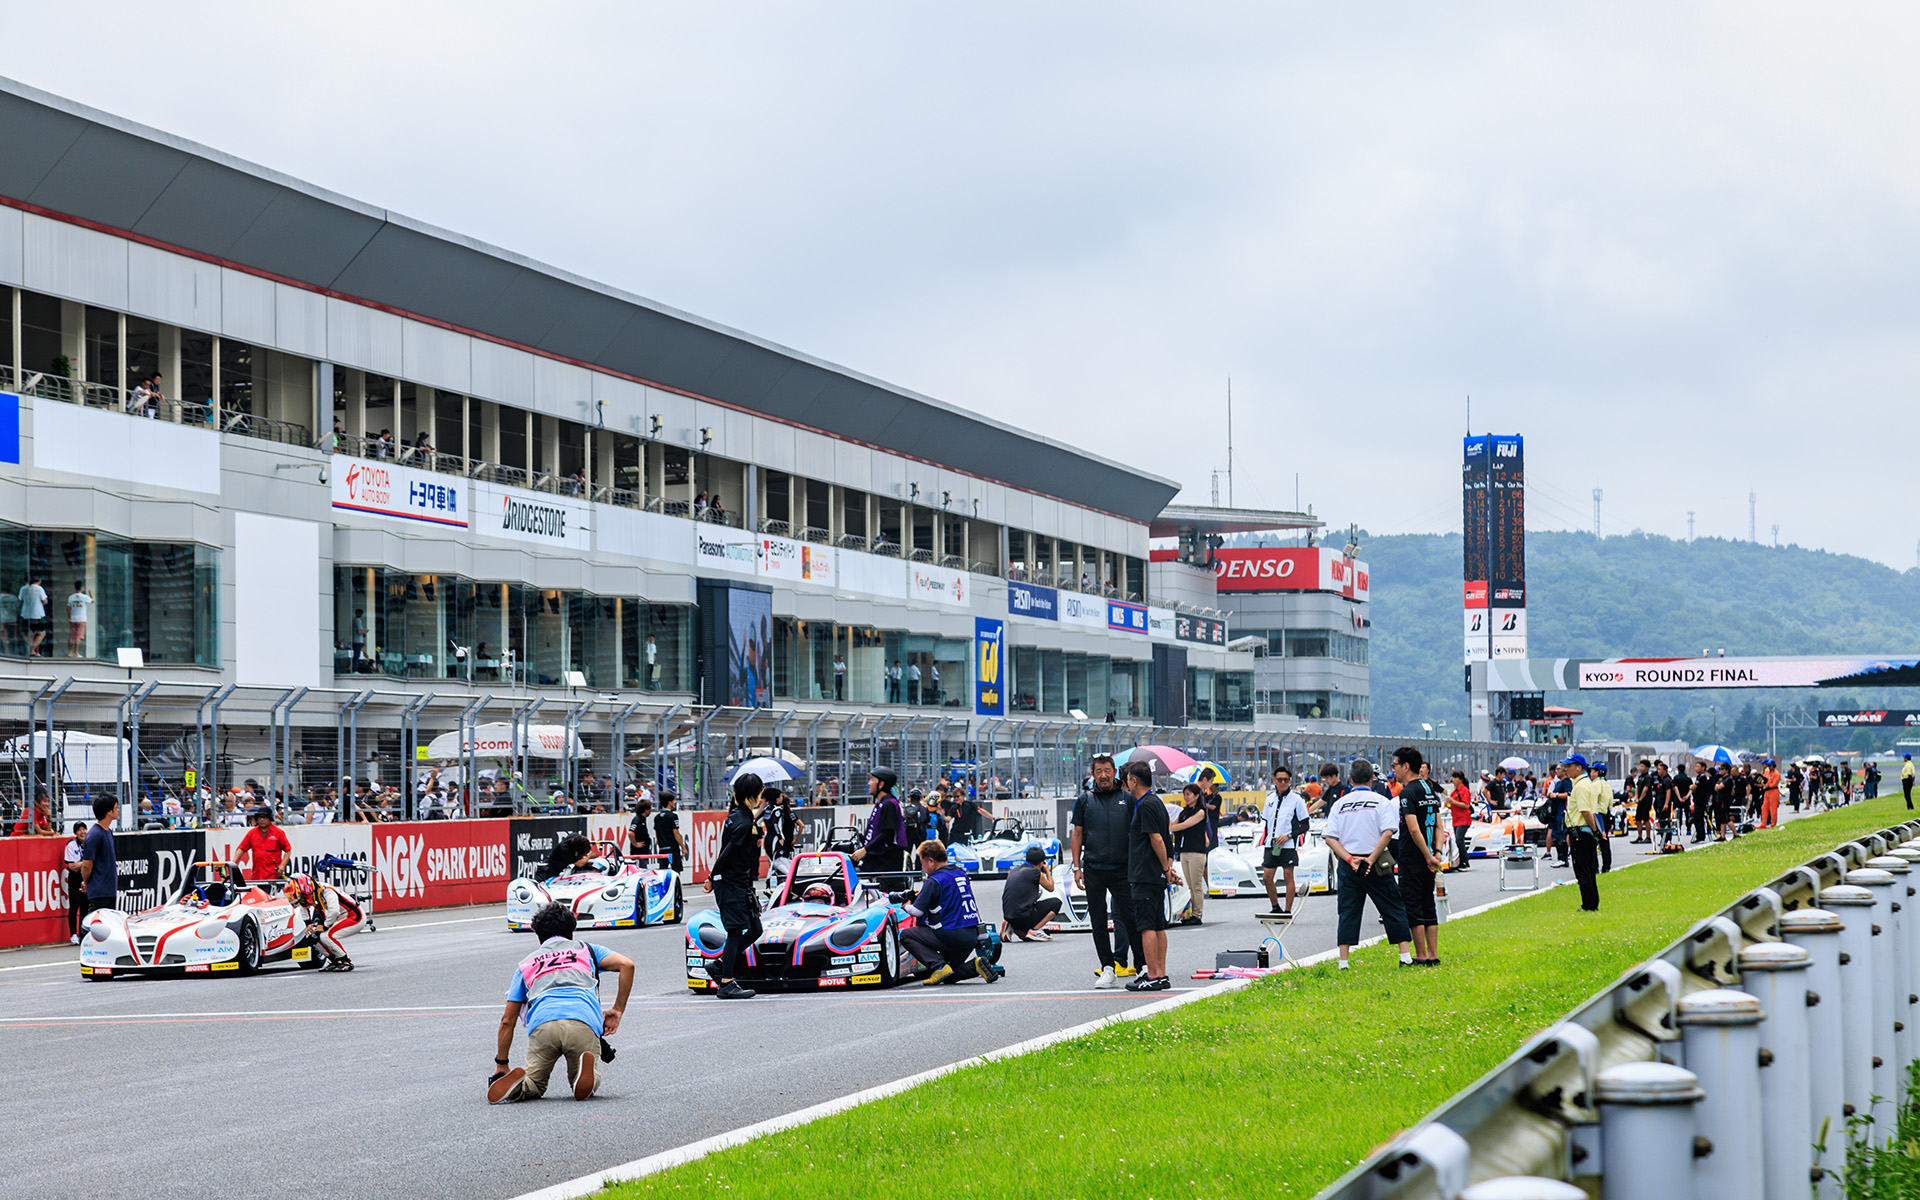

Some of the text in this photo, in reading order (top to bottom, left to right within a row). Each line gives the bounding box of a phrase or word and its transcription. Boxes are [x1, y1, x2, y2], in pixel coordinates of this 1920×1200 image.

[1496, 444, 1517, 457] FUJI
[361, 466, 390, 489] TOYOTA
[1496, 472, 1523, 481] 12 45
[362, 488, 390, 505] AUTO BODY
[409, 481, 457, 512] トヨタ車体
[1500, 490, 1523, 499] 1 86
[1499, 499, 1523, 507] 2 114
[503, 496, 565, 538] BRIDGESTONE
[1499, 508, 1523, 517] 3 17
[1512, 517, 1523, 526] 38
[1499, 526, 1505, 535] 5
[699, 535, 725, 557] Panasonic
[1499, 535, 1523, 544] 6 50
[1499, 544, 1523, 553] 7 87
[1499, 553, 1522, 562] 8 761
[1215, 559, 1295, 578] DENSO
[1500, 562, 1505, 570] 9
[1496, 571, 1523, 580] 10 34
[980, 640, 998, 684] GO
[1636, 670, 1705, 682] ROUND2
[1711, 669, 1758, 681] FINAL
[1825, 714, 1882, 722] ADVAN
[1340, 801, 1379, 811] PFC
[814, 818, 832, 852] RY
[517, 833, 531, 851] NGK
[591, 826, 627, 858] NGK
[133, 859, 149, 875] PLUG
[375, 833, 424, 900] NGK
[427, 847, 466, 882] SPARK
[469, 844, 507, 878] PLUGS
[155, 849, 197, 906] RY
[10, 868, 70, 913] PLUGS
[534, 950, 573, 964] MEDIA
